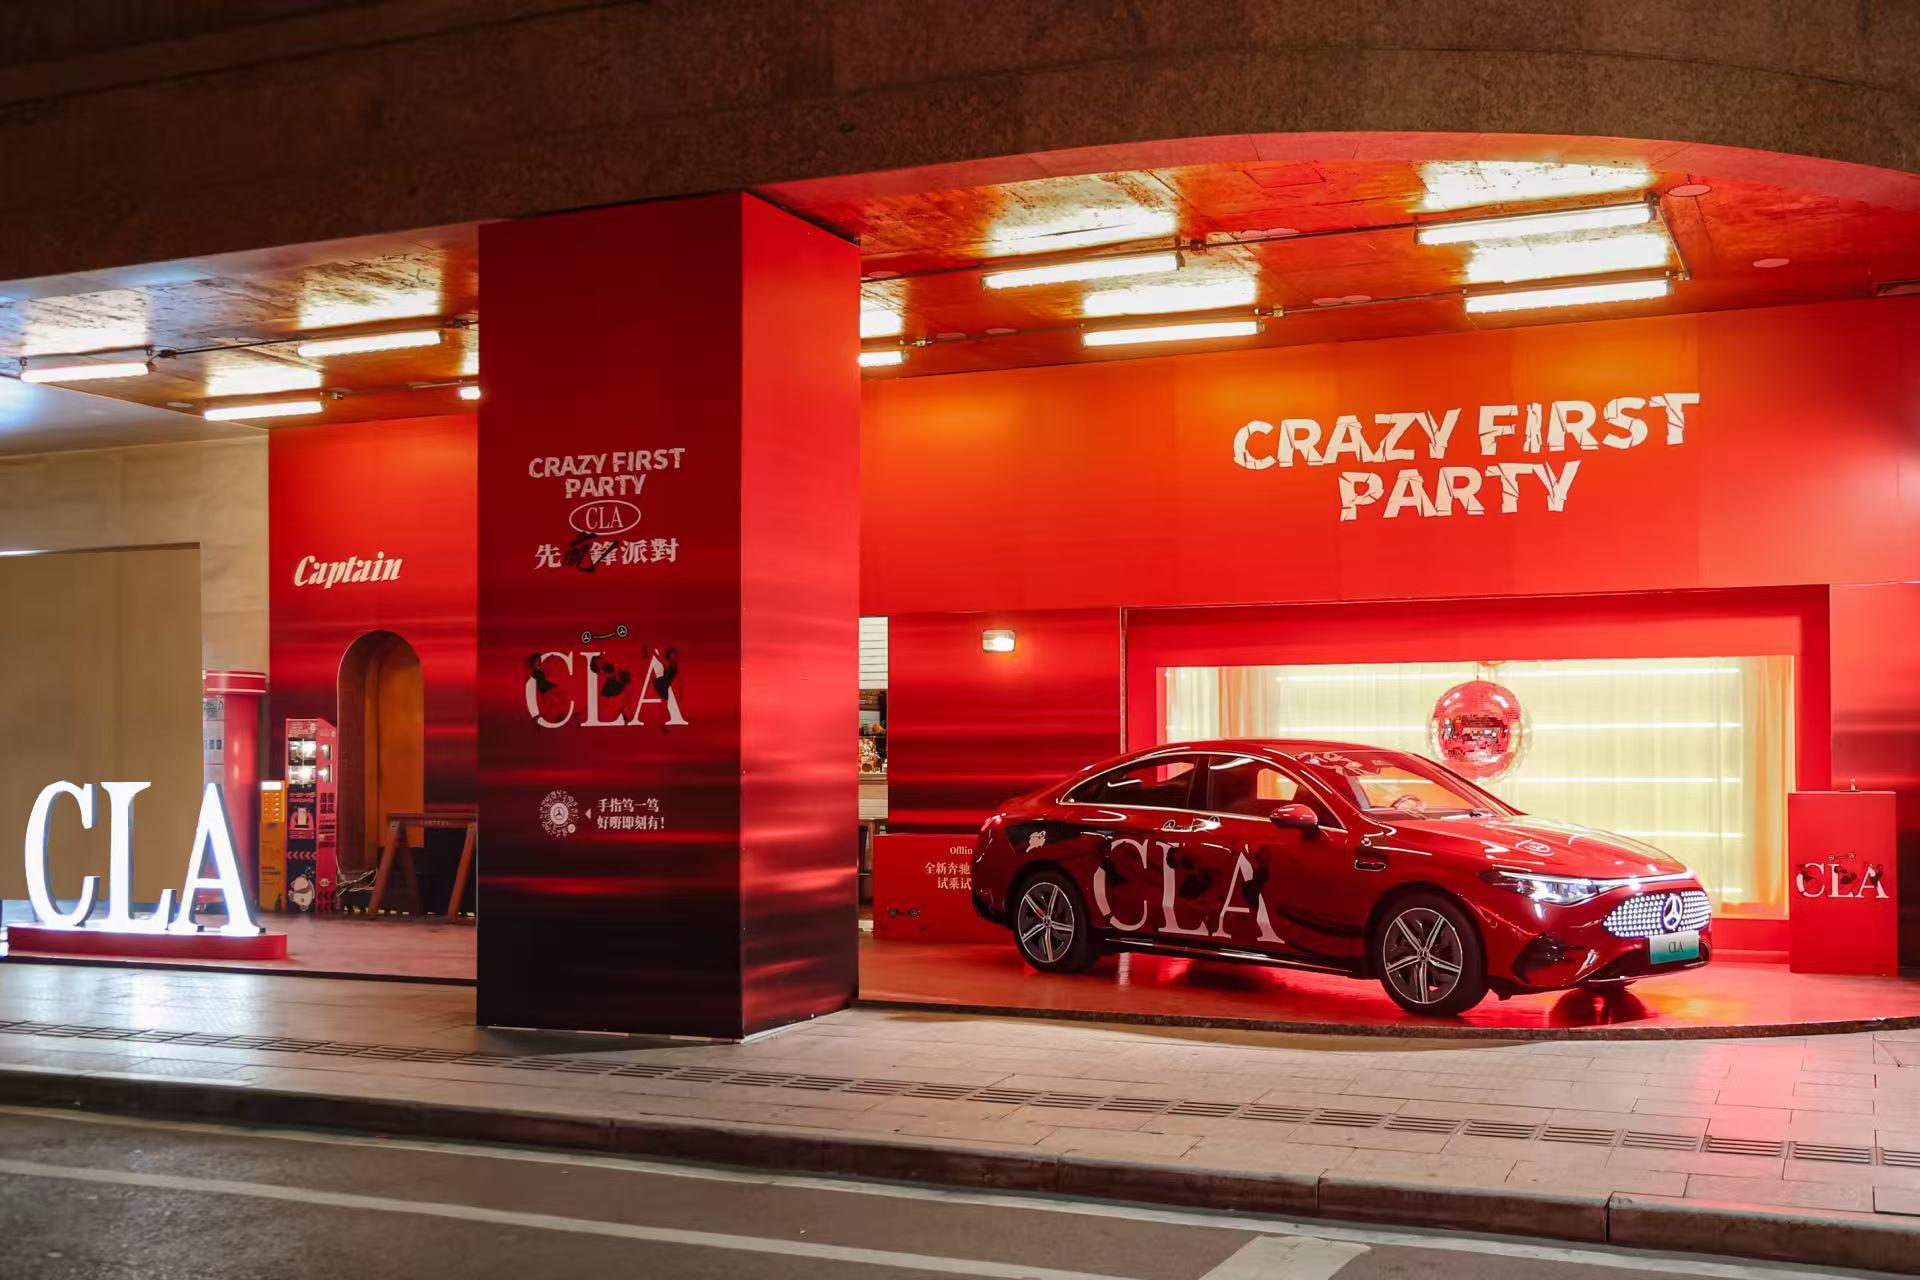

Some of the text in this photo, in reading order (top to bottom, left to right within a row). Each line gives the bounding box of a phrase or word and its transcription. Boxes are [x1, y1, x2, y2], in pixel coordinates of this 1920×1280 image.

[1232, 392, 1701, 469] CRAZY FIRST
[528, 447, 686, 478] CRAZY FIRST
[565, 474, 647, 499] PARTY
[1338, 460, 1582, 521] PARTY
[585, 506, 624, 530] CLA
[294, 551, 403, 589] Captain
[525, 649, 689, 729] CLA
[598, 797, 660, 813] 手指笃一笃
[24, 780, 263, 937] CLA
[949, 846, 973, 855] Offlin
[937, 876, 972, 891] 试乘试
[1093, 837, 1286, 945] CLA
[1795, 862, 1889, 899] CLA
[1668, 940, 1685, 954] CLA
